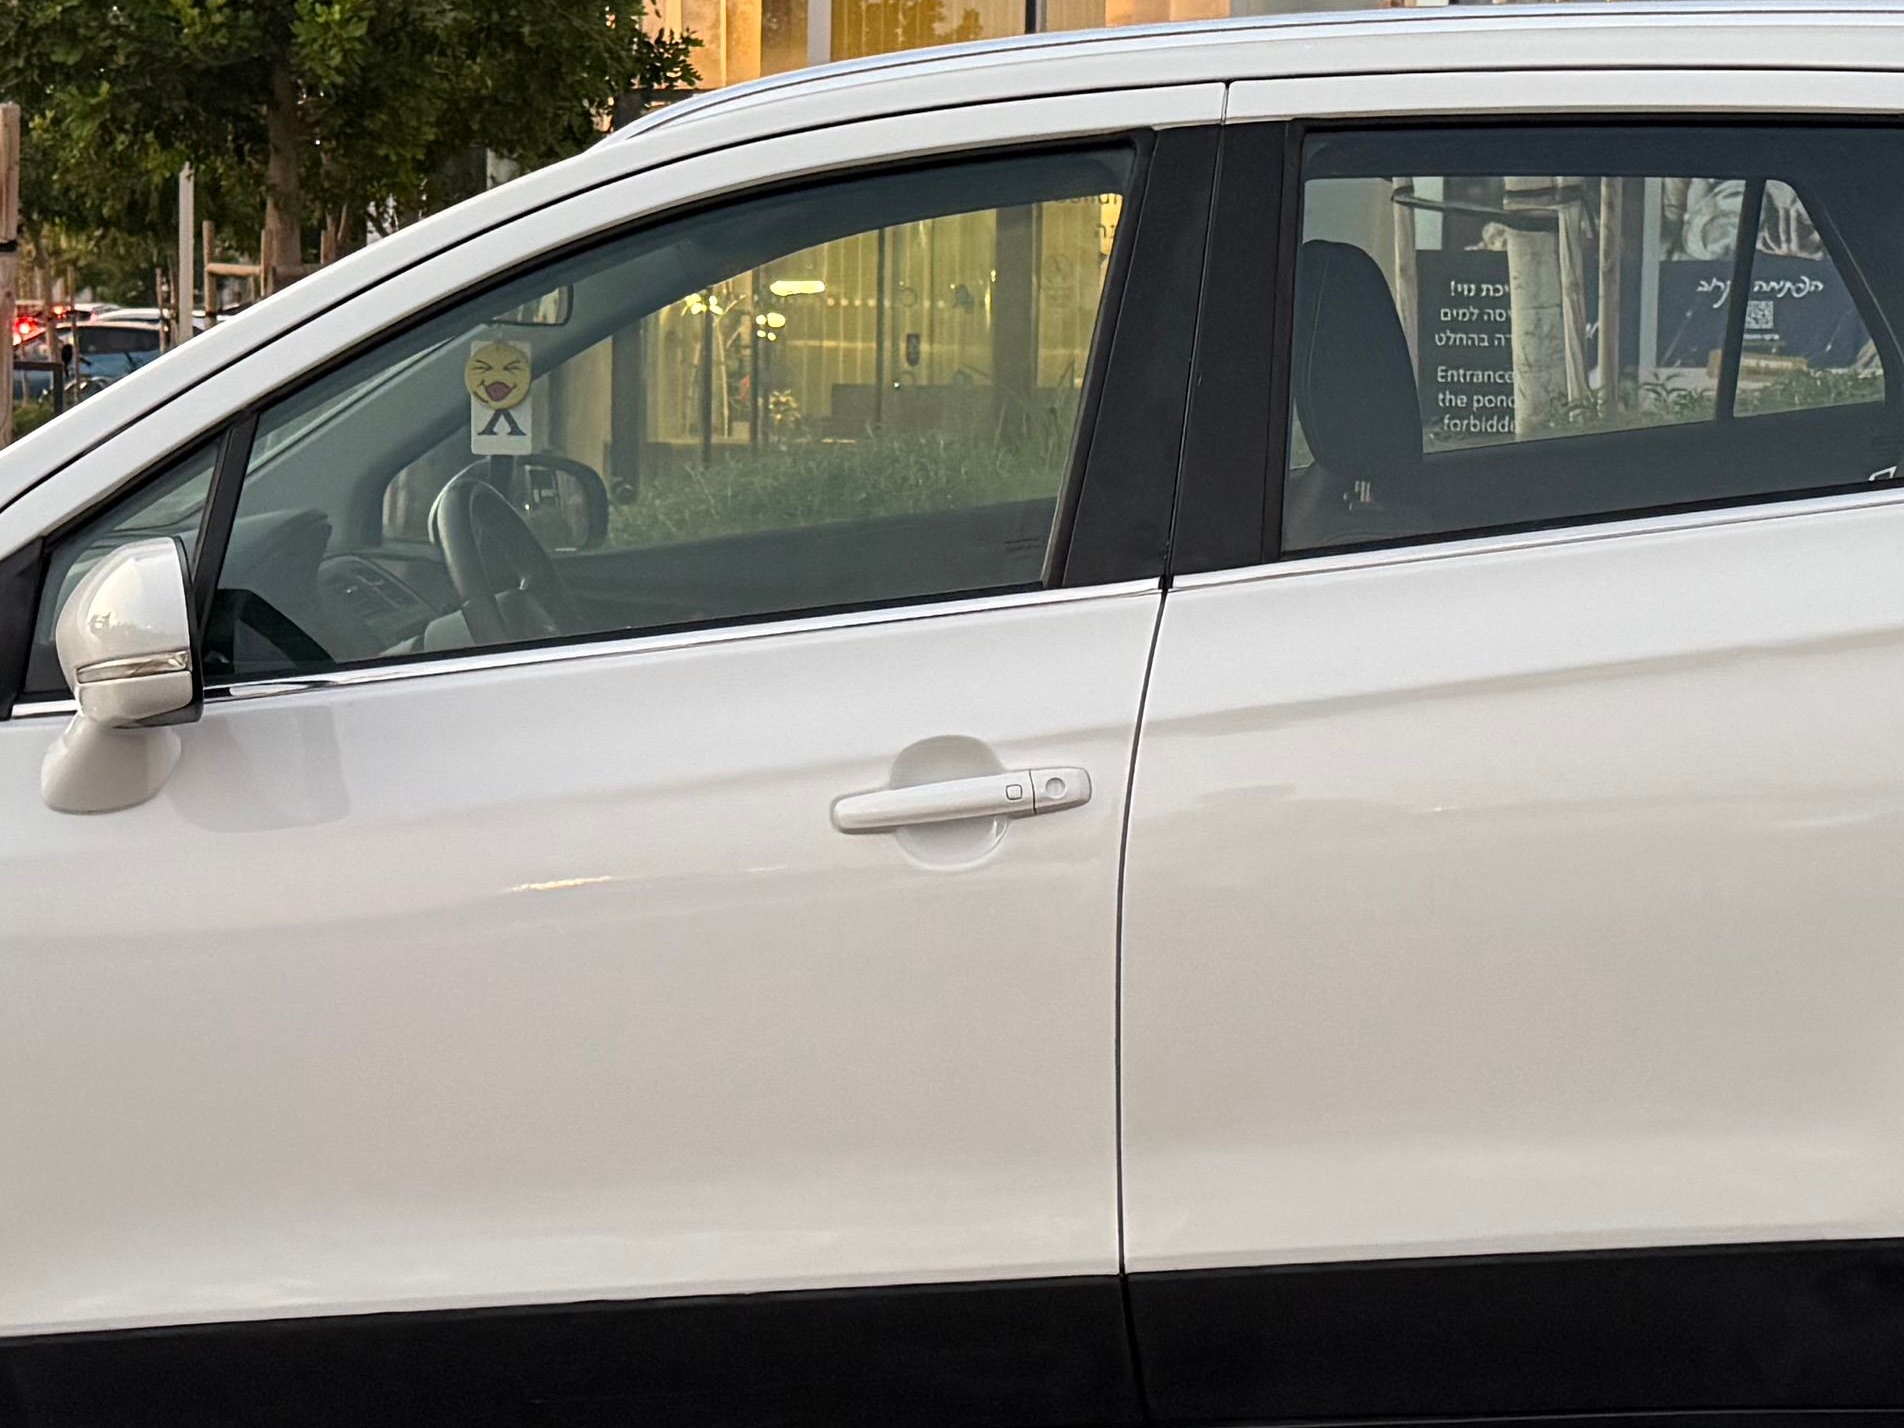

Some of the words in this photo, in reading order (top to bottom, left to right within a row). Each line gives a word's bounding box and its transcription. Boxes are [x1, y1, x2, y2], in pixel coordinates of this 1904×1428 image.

[1450, 280, 1476, 297] נוי!
[1753, 275, 1824, 298] הפתיחה
[1440, 305, 1479, 321] למים
[1434, 329, 1489, 346] בהחלט
[1437, 365, 1514, 383] Entrance
[1438, 390, 1467, 408] the
[1443, 414, 1516, 433] forbidd
